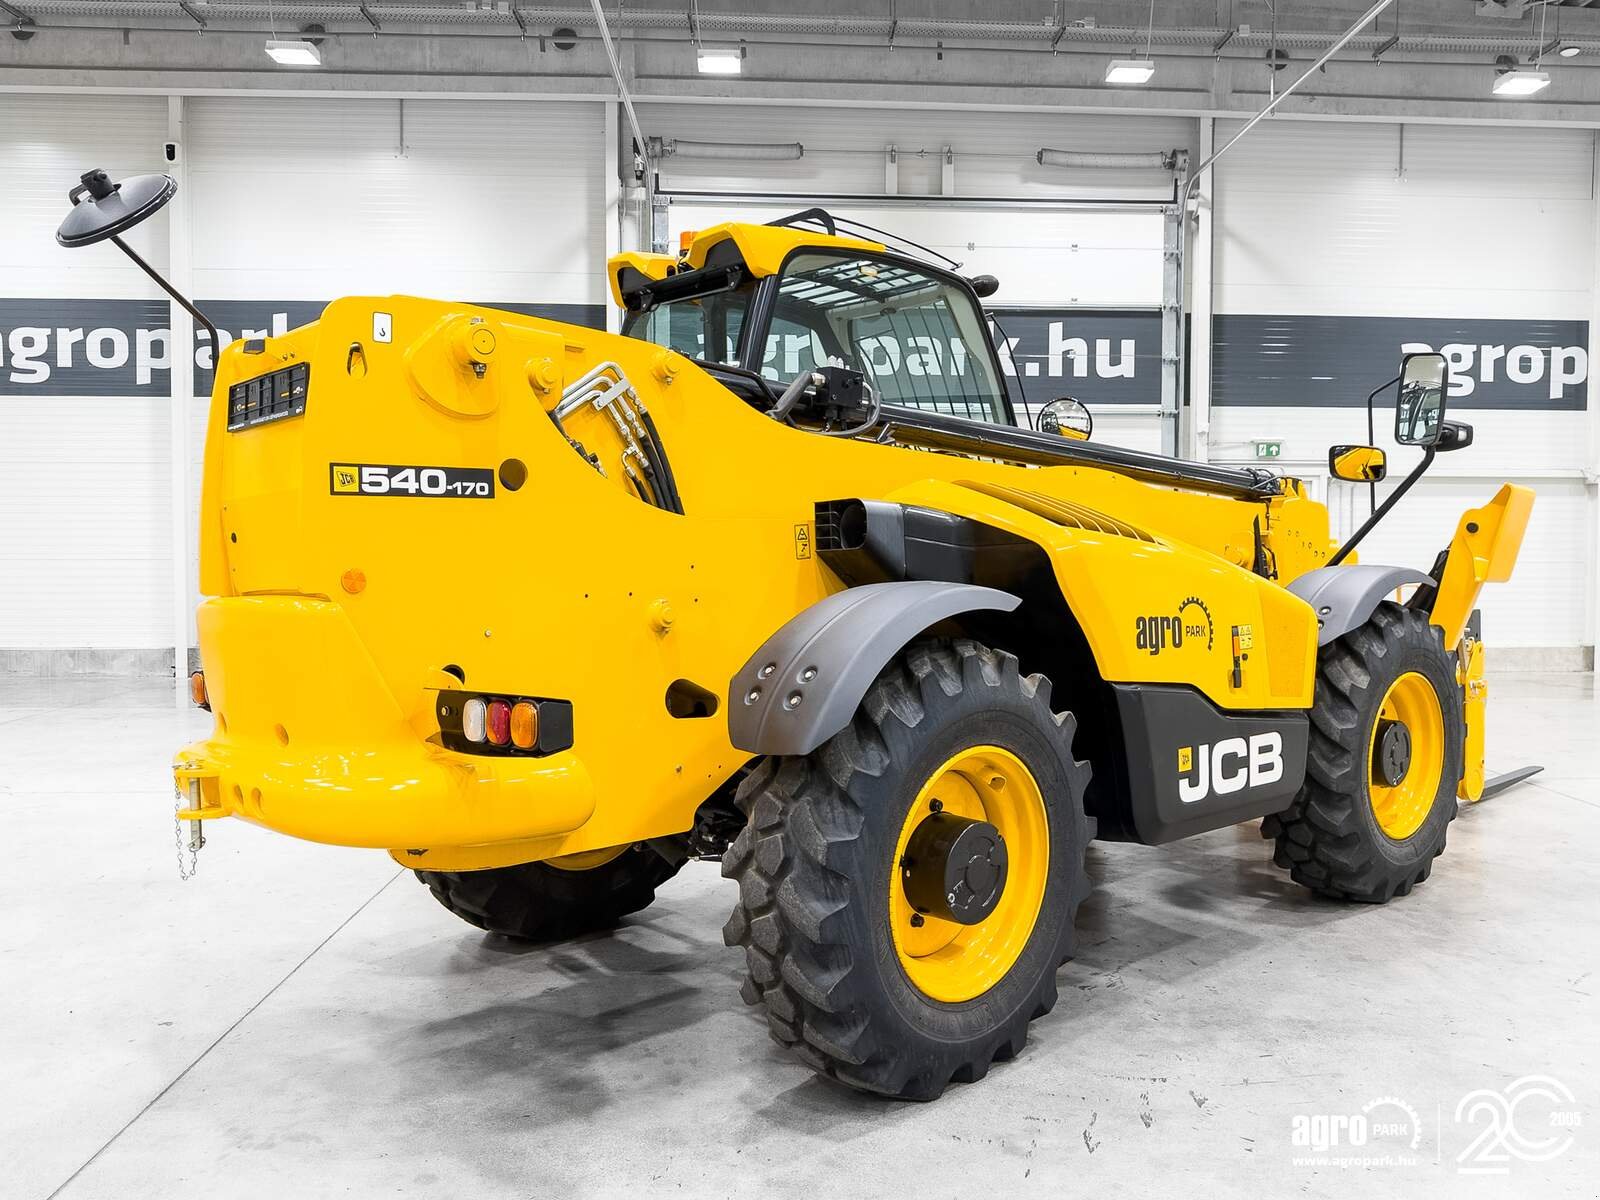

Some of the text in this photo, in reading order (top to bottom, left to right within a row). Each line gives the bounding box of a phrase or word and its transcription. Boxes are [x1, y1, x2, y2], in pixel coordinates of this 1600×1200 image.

[1400, 343, 1587, 399] grop
[361, 466, 489, 496] 540-170
[1136, 616, 1206, 655] agro PARK
[1178, 732, 1283, 803] JCB
